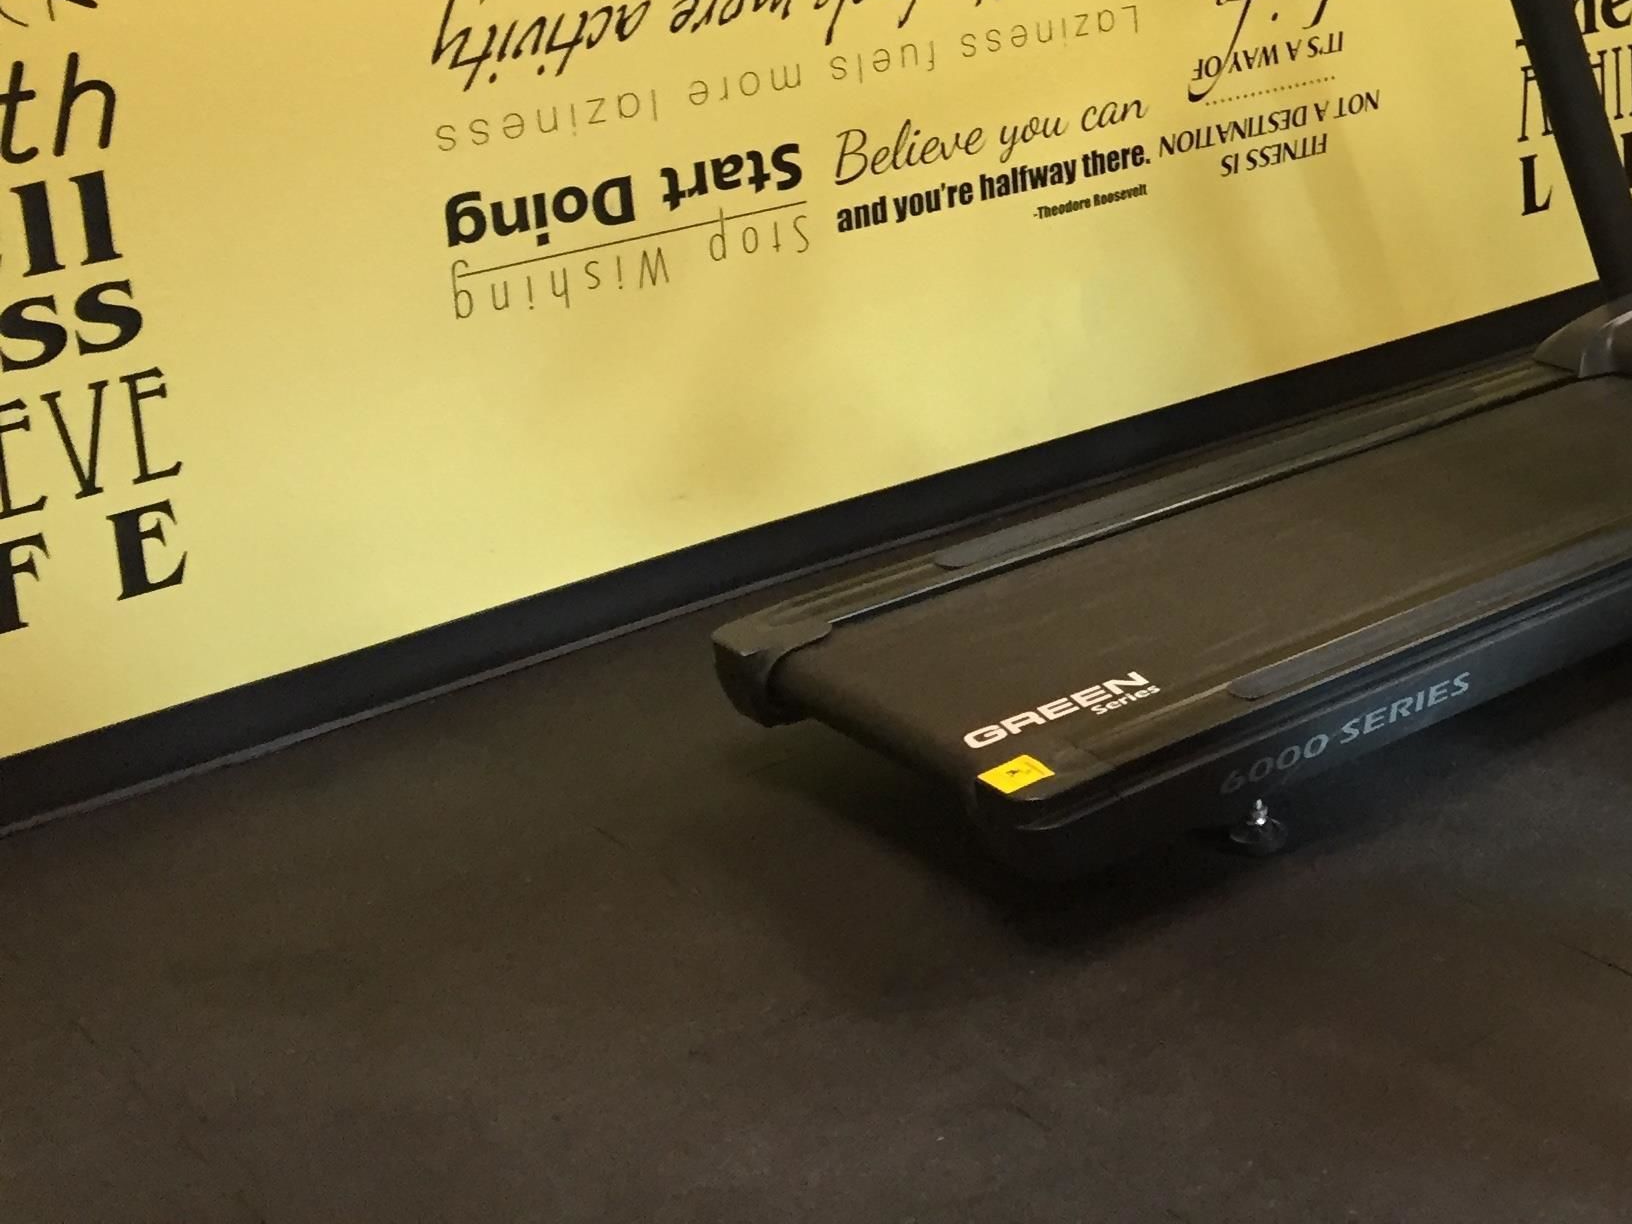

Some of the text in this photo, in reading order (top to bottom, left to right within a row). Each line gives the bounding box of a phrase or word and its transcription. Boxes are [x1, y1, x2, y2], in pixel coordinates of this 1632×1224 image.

[435, 4, 1140, 152] Laziness fuels more laziness
[1191, 31, 1344, 81] IT'S A WAY OF
[834, 99, 1151, 186] Believe you can
[1159, 89, 1381, 158] NOT A DESTINATION
[1221, 133, 1328, 178] FITNESS IS
[445, 142, 803, 247] Start Doing
[837, 144, 1151, 233] and you're halfway there.
[1093, 183, 1148, 207] Roosevelt
[452, 207, 809, 319] Stop Wishing
[963, 671, 1152, 750] GREEN
[1090, 682, 1161, 716] Series
[1220, 671, 1473, 796] 6000 SERIES
